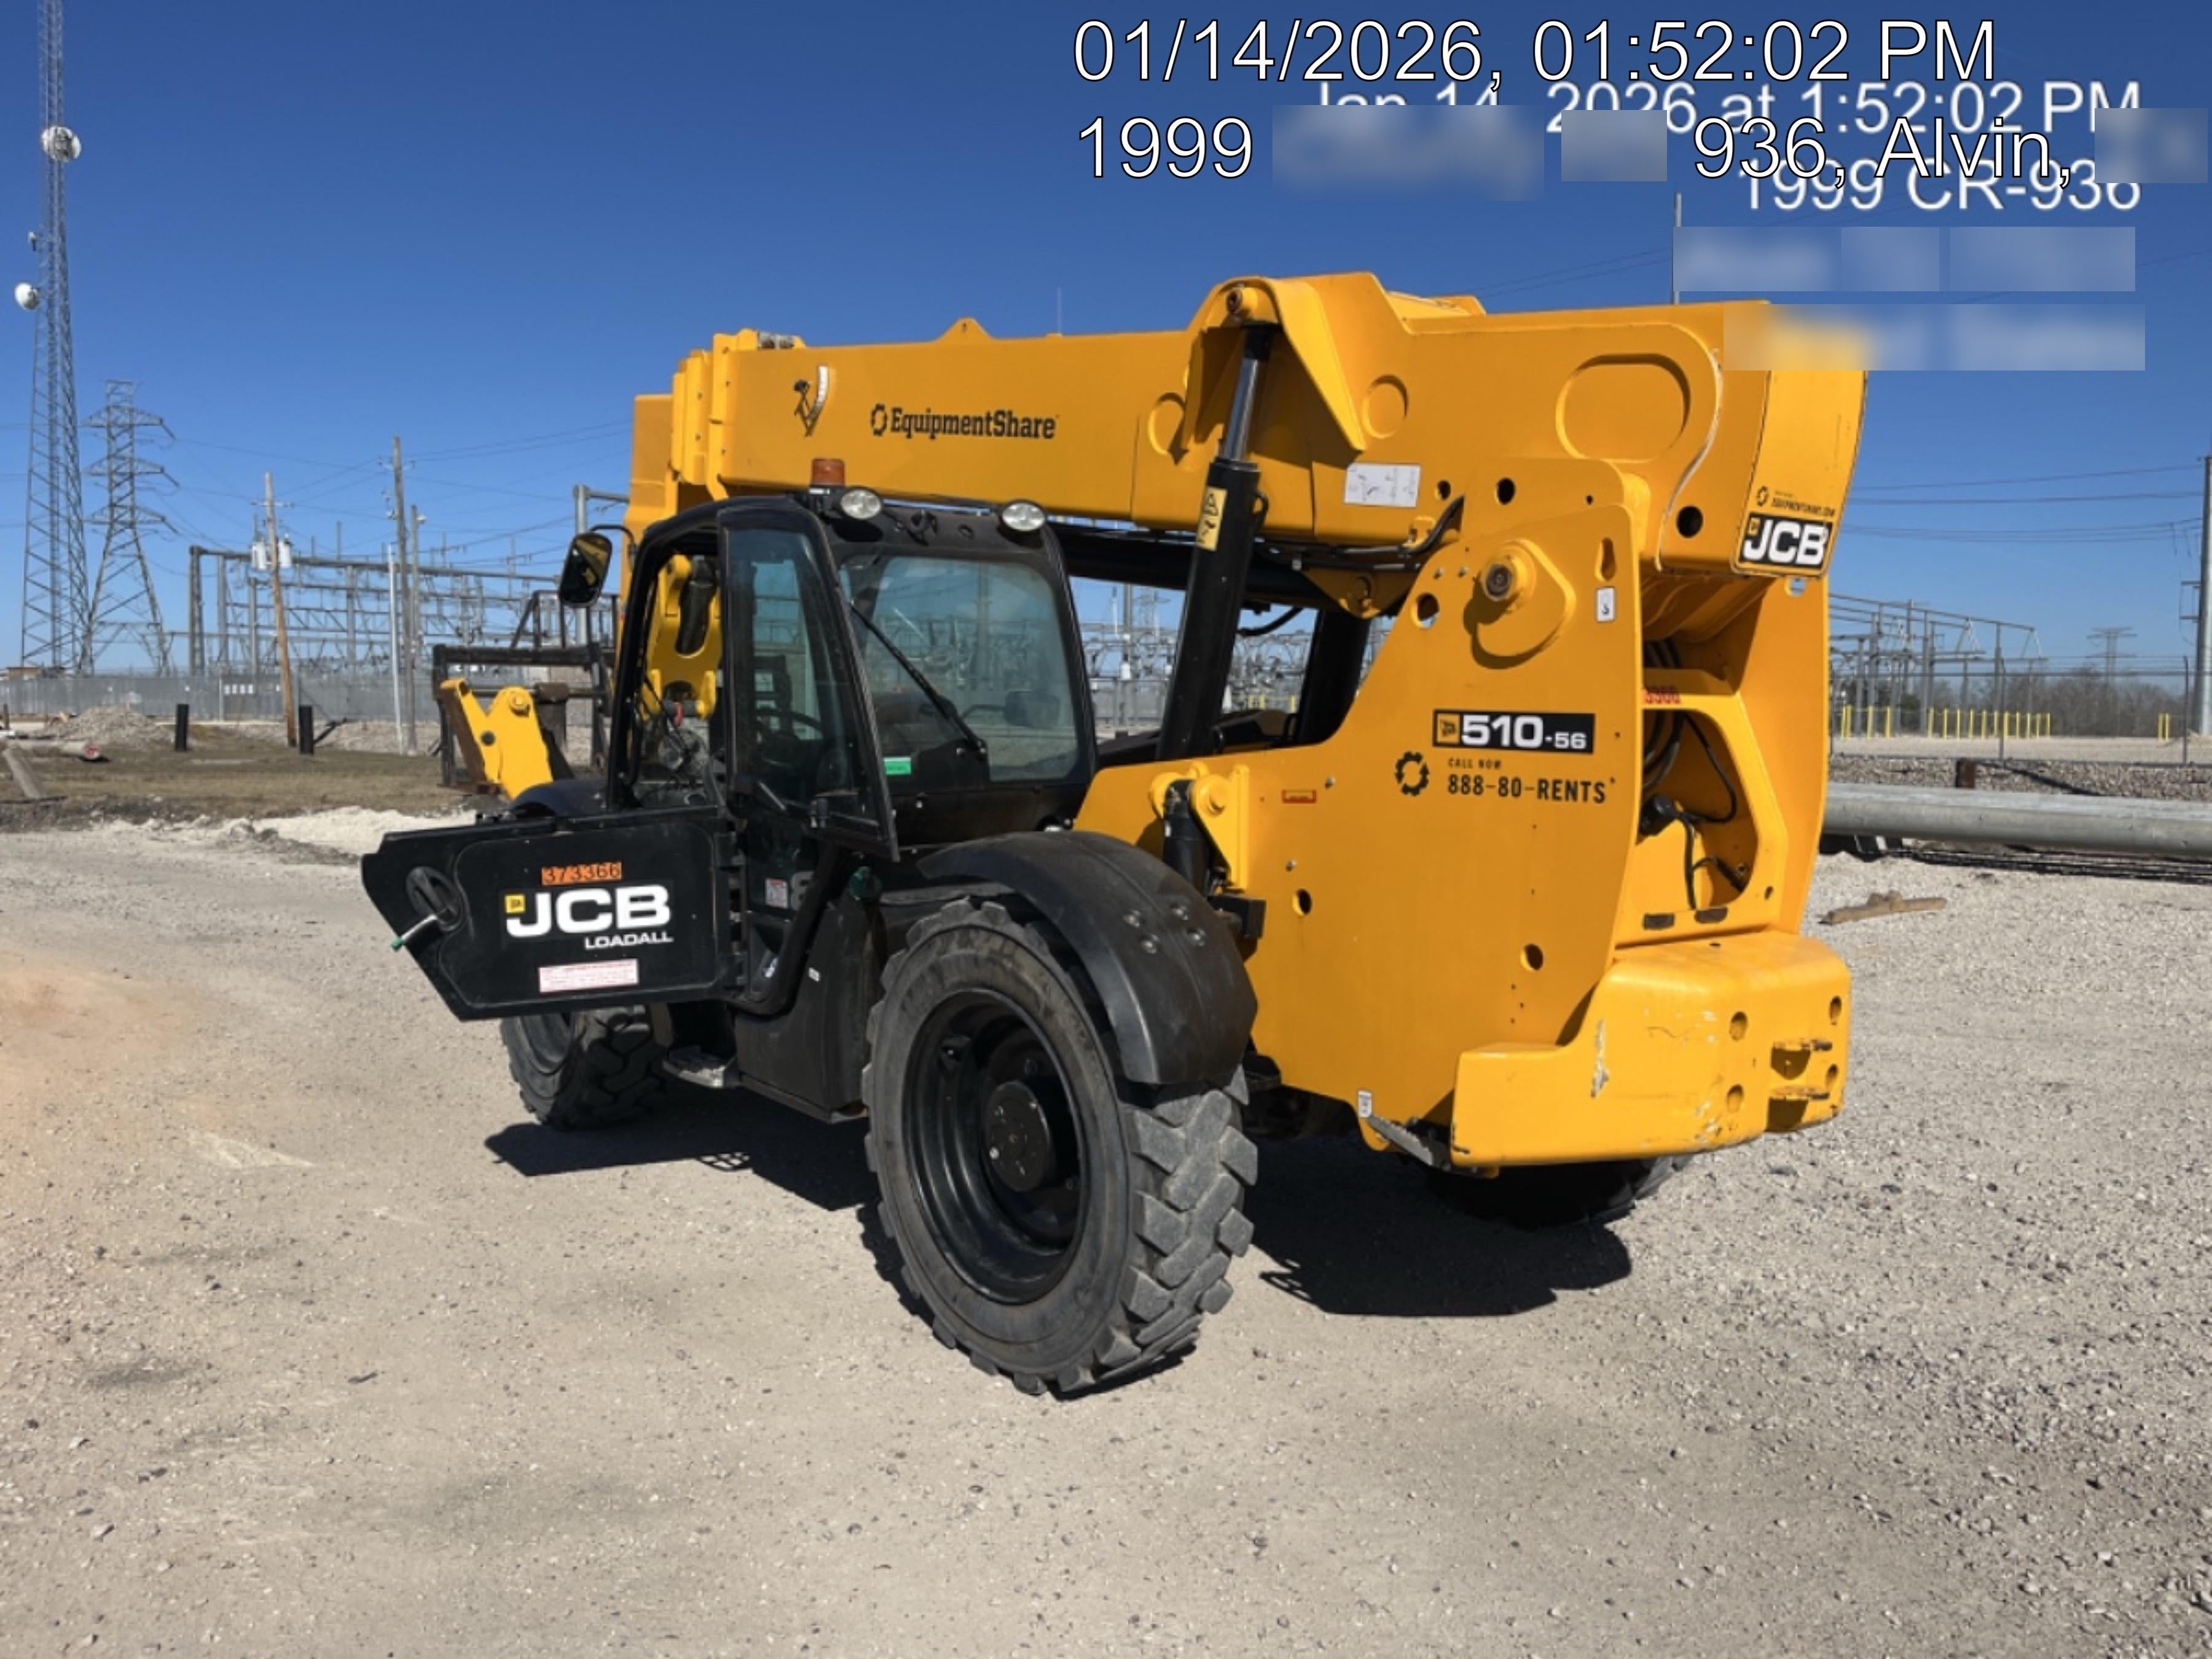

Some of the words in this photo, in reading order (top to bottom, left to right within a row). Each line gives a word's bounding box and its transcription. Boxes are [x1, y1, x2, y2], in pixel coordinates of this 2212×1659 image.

[891, 407, 1056, 440] EquipmentShare
[1743, 519, 1829, 565] JCB
[1448, 757, 1473, 769] CALL
[1478, 758, 1502, 769] NOW
[1448, 774, 1606, 804] 888-80-RENTS
[506, 885, 671, 938] JCB
[586, 931, 674, 950] LOADALL
